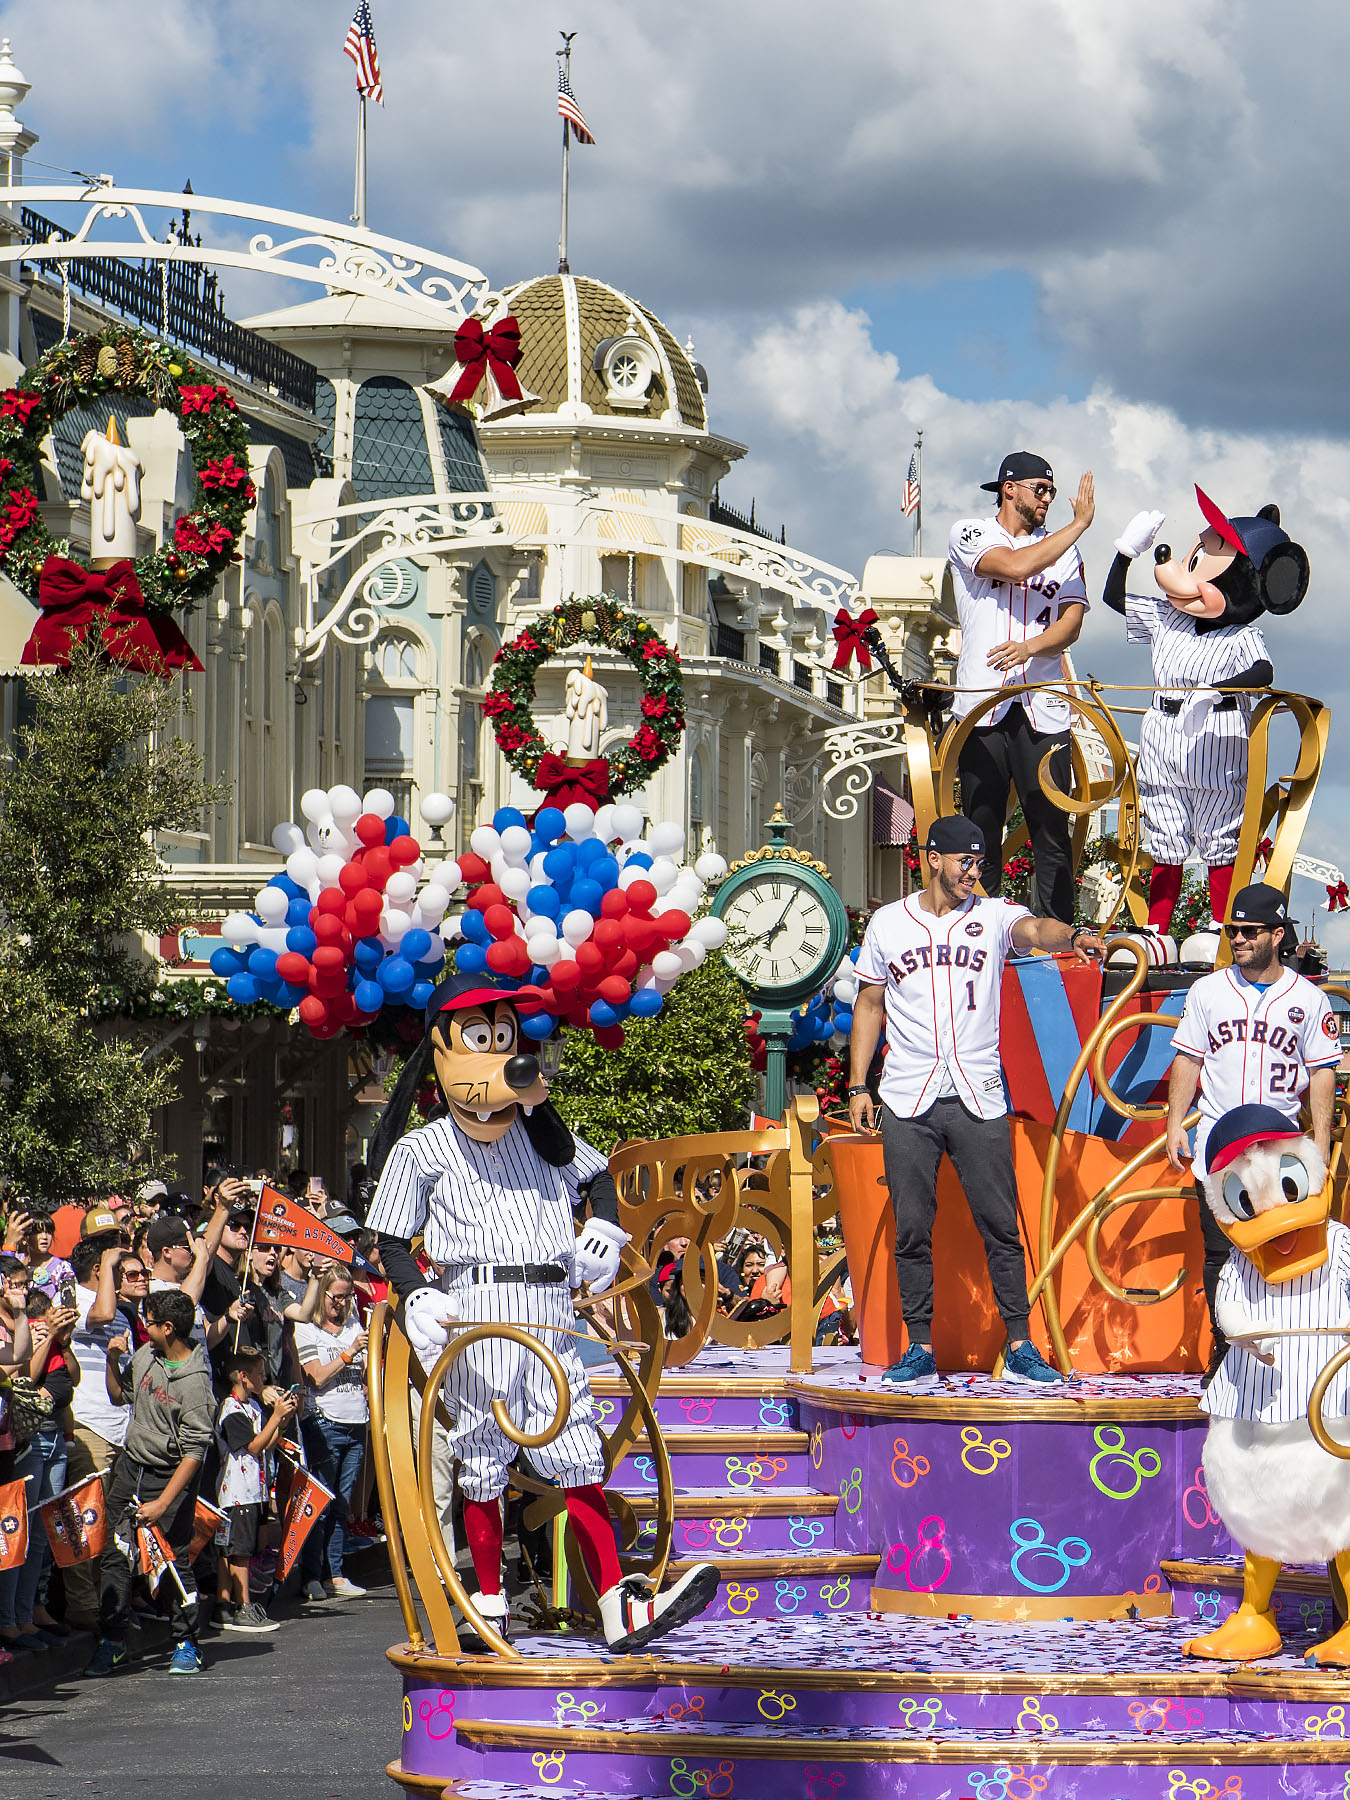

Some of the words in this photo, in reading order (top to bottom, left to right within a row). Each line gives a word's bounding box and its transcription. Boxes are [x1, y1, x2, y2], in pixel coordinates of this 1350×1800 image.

[1035, 605, 1052, 632] 4
[888, 944, 988, 985] ASTROS
[965, 980, 977, 1012] 1
[1207, 1018, 1298, 1056] ASTROS
[1270, 1062, 1299, 1093] 27
[304, 1228, 345, 1256] ASTROS
